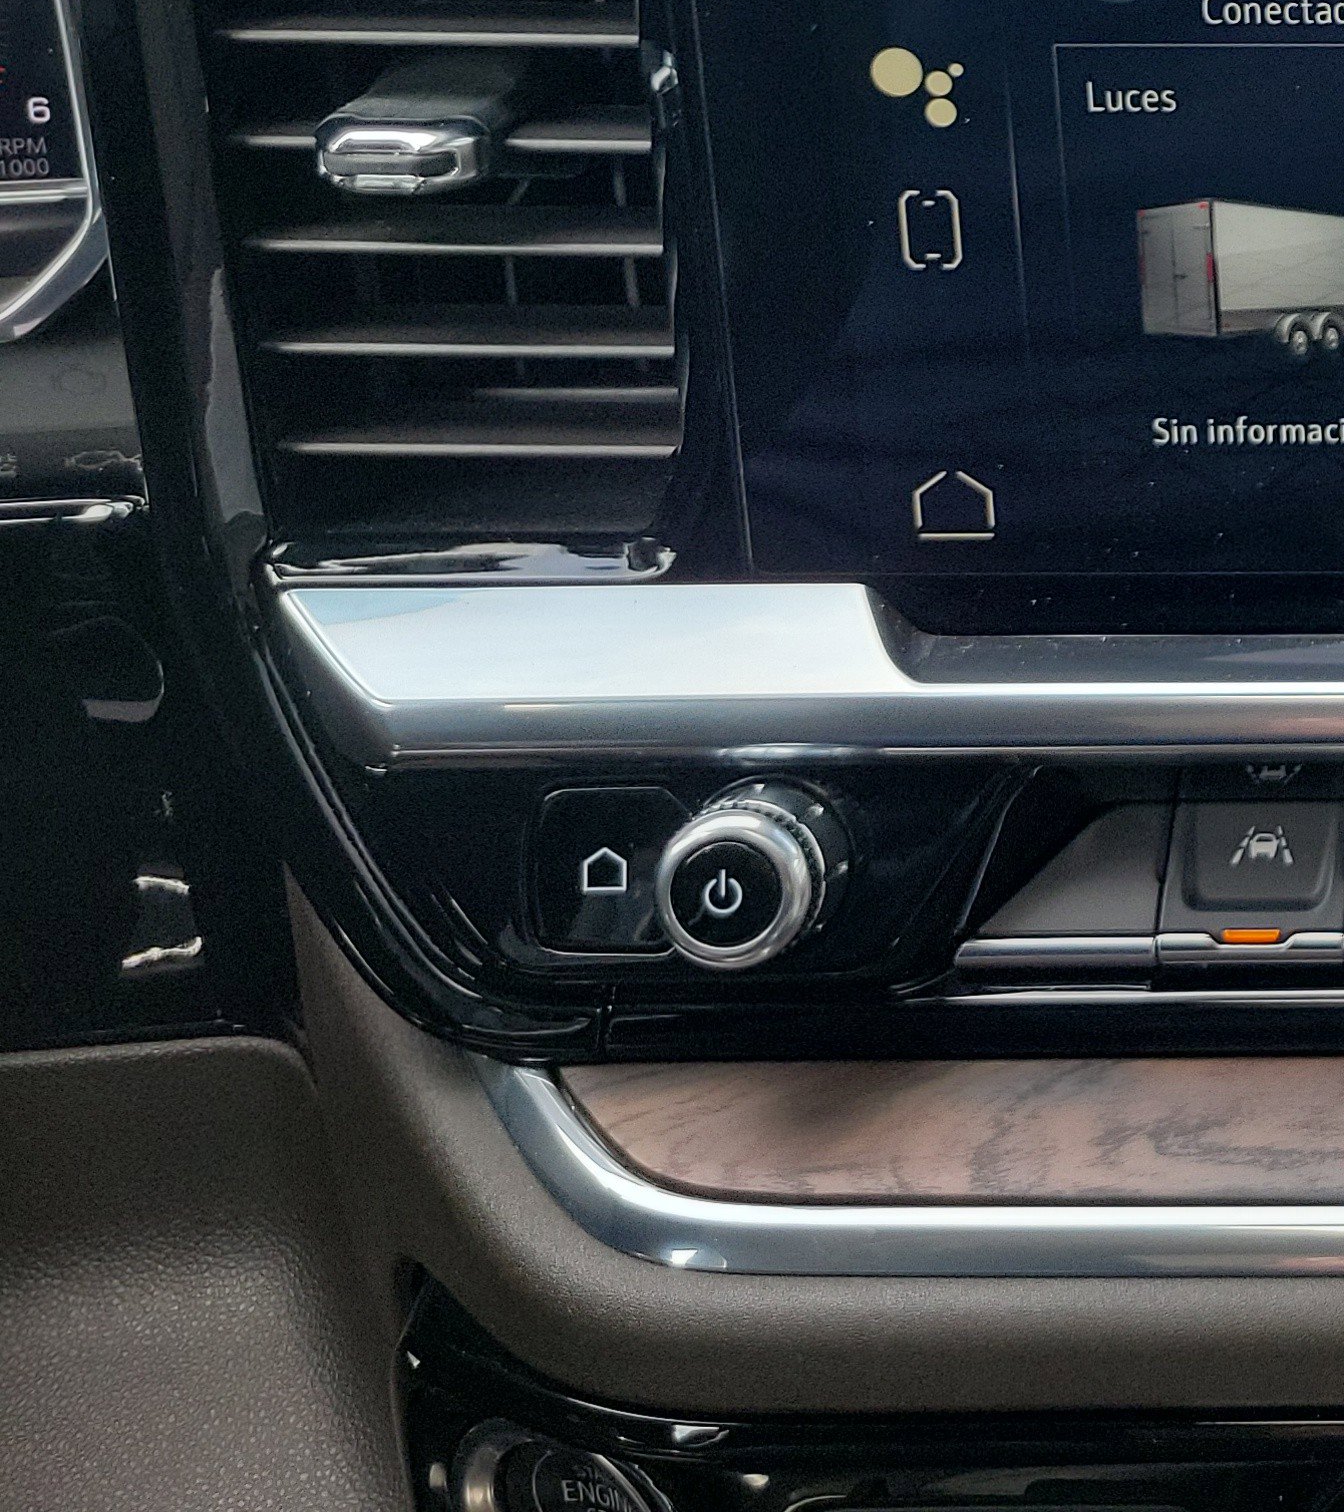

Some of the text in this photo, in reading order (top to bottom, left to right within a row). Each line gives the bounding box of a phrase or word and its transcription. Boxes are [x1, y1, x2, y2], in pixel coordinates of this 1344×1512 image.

[26, 96, 51, 124] 6
[1086, 81, 1177, 113] Luces
[0, 137, 47, 155] RPM
[1152, 417, 1198, 445] Sin
